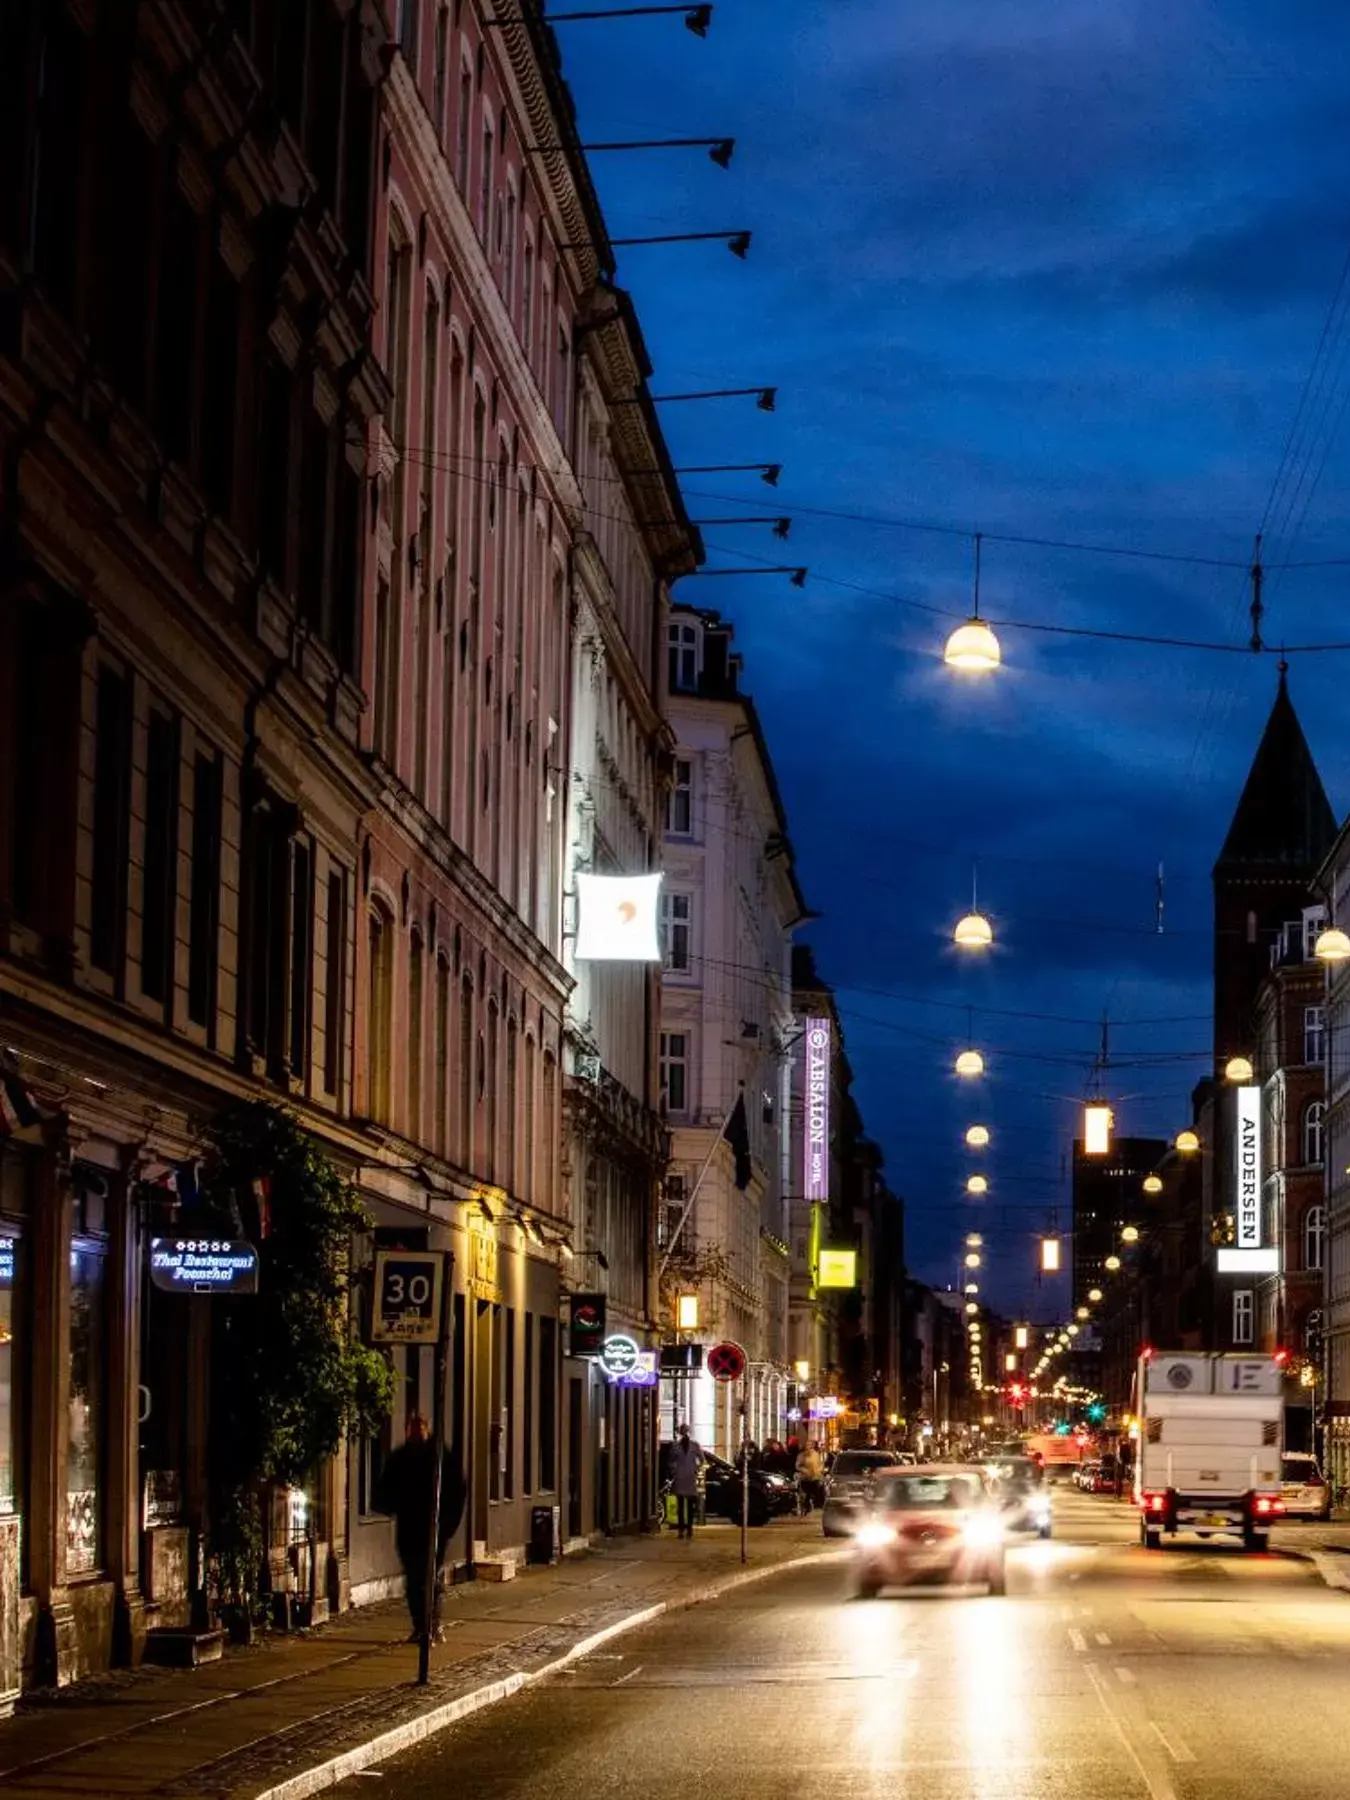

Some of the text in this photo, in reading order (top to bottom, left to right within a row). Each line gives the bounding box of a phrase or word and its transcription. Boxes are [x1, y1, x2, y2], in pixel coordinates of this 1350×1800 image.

[810, 1056, 825, 1143] ABSALON
[1242, 1117, 1256, 1240] ANDERSEN
[386, 1274, 429, 1304] 30
